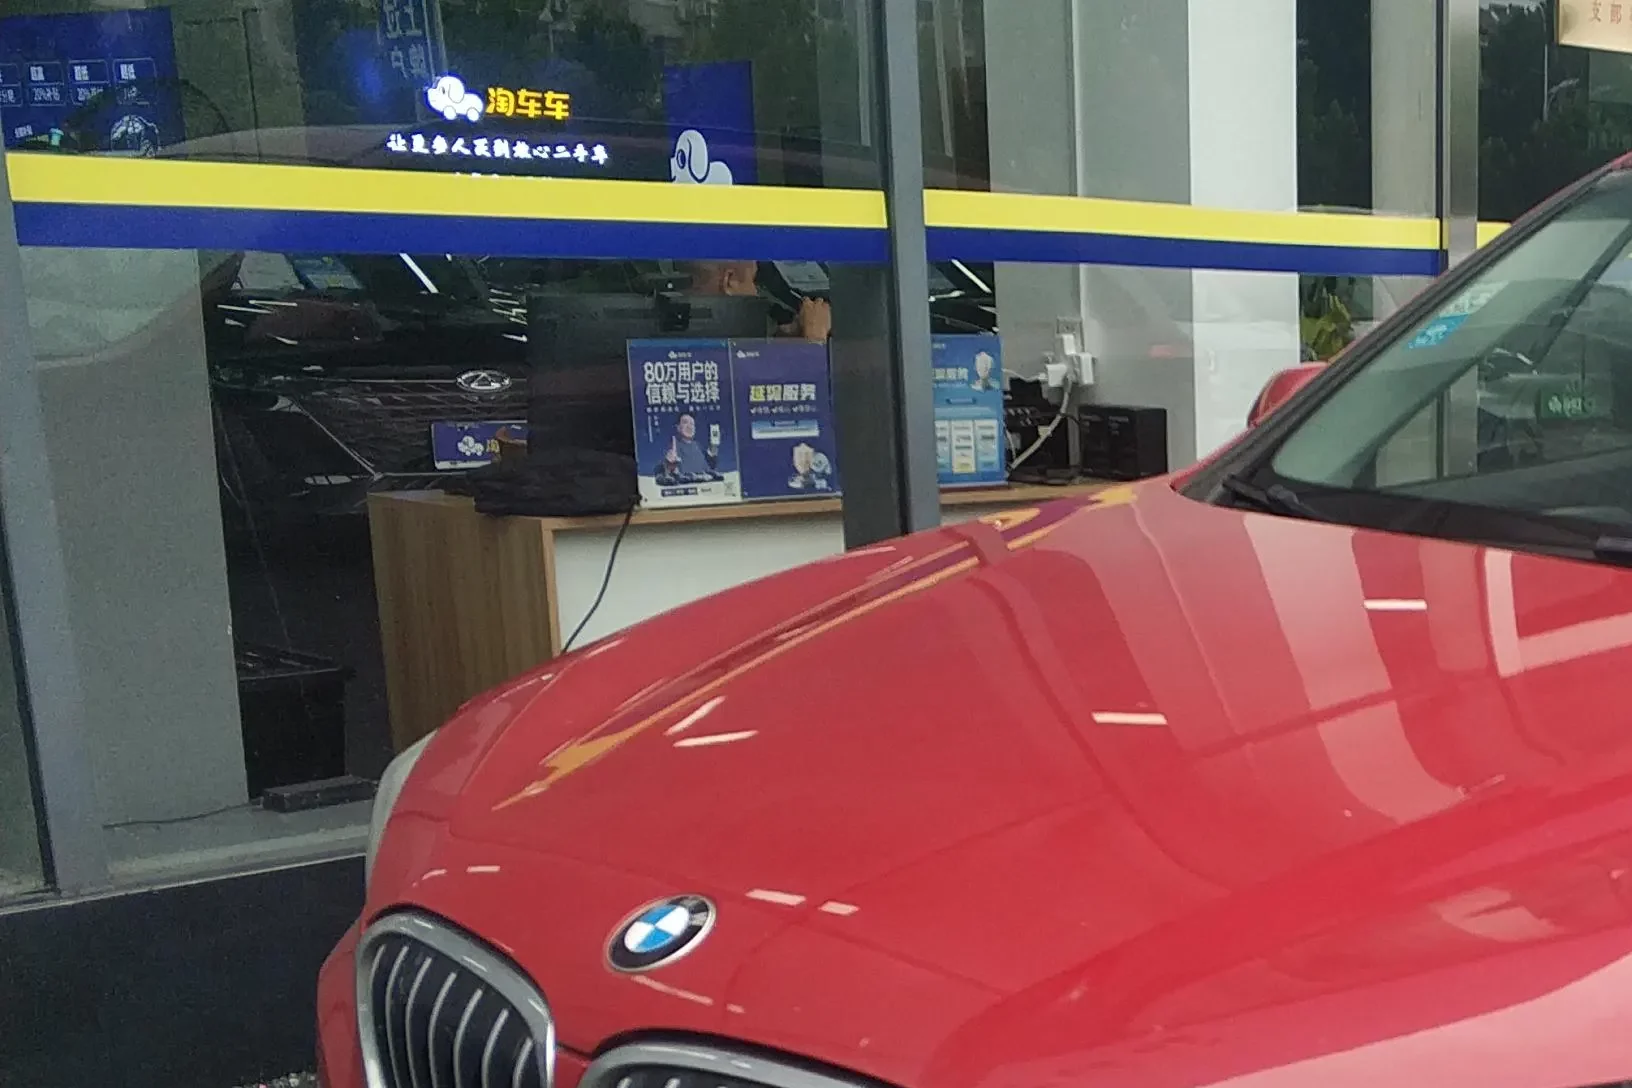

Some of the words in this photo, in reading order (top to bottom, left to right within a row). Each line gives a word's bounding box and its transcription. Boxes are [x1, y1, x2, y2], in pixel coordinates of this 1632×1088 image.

[486, 87, 570, 120] 淘车车
[644, 360, 719, 383] 80万用户的
[646, 381, 720, 405] 信赖与选择
